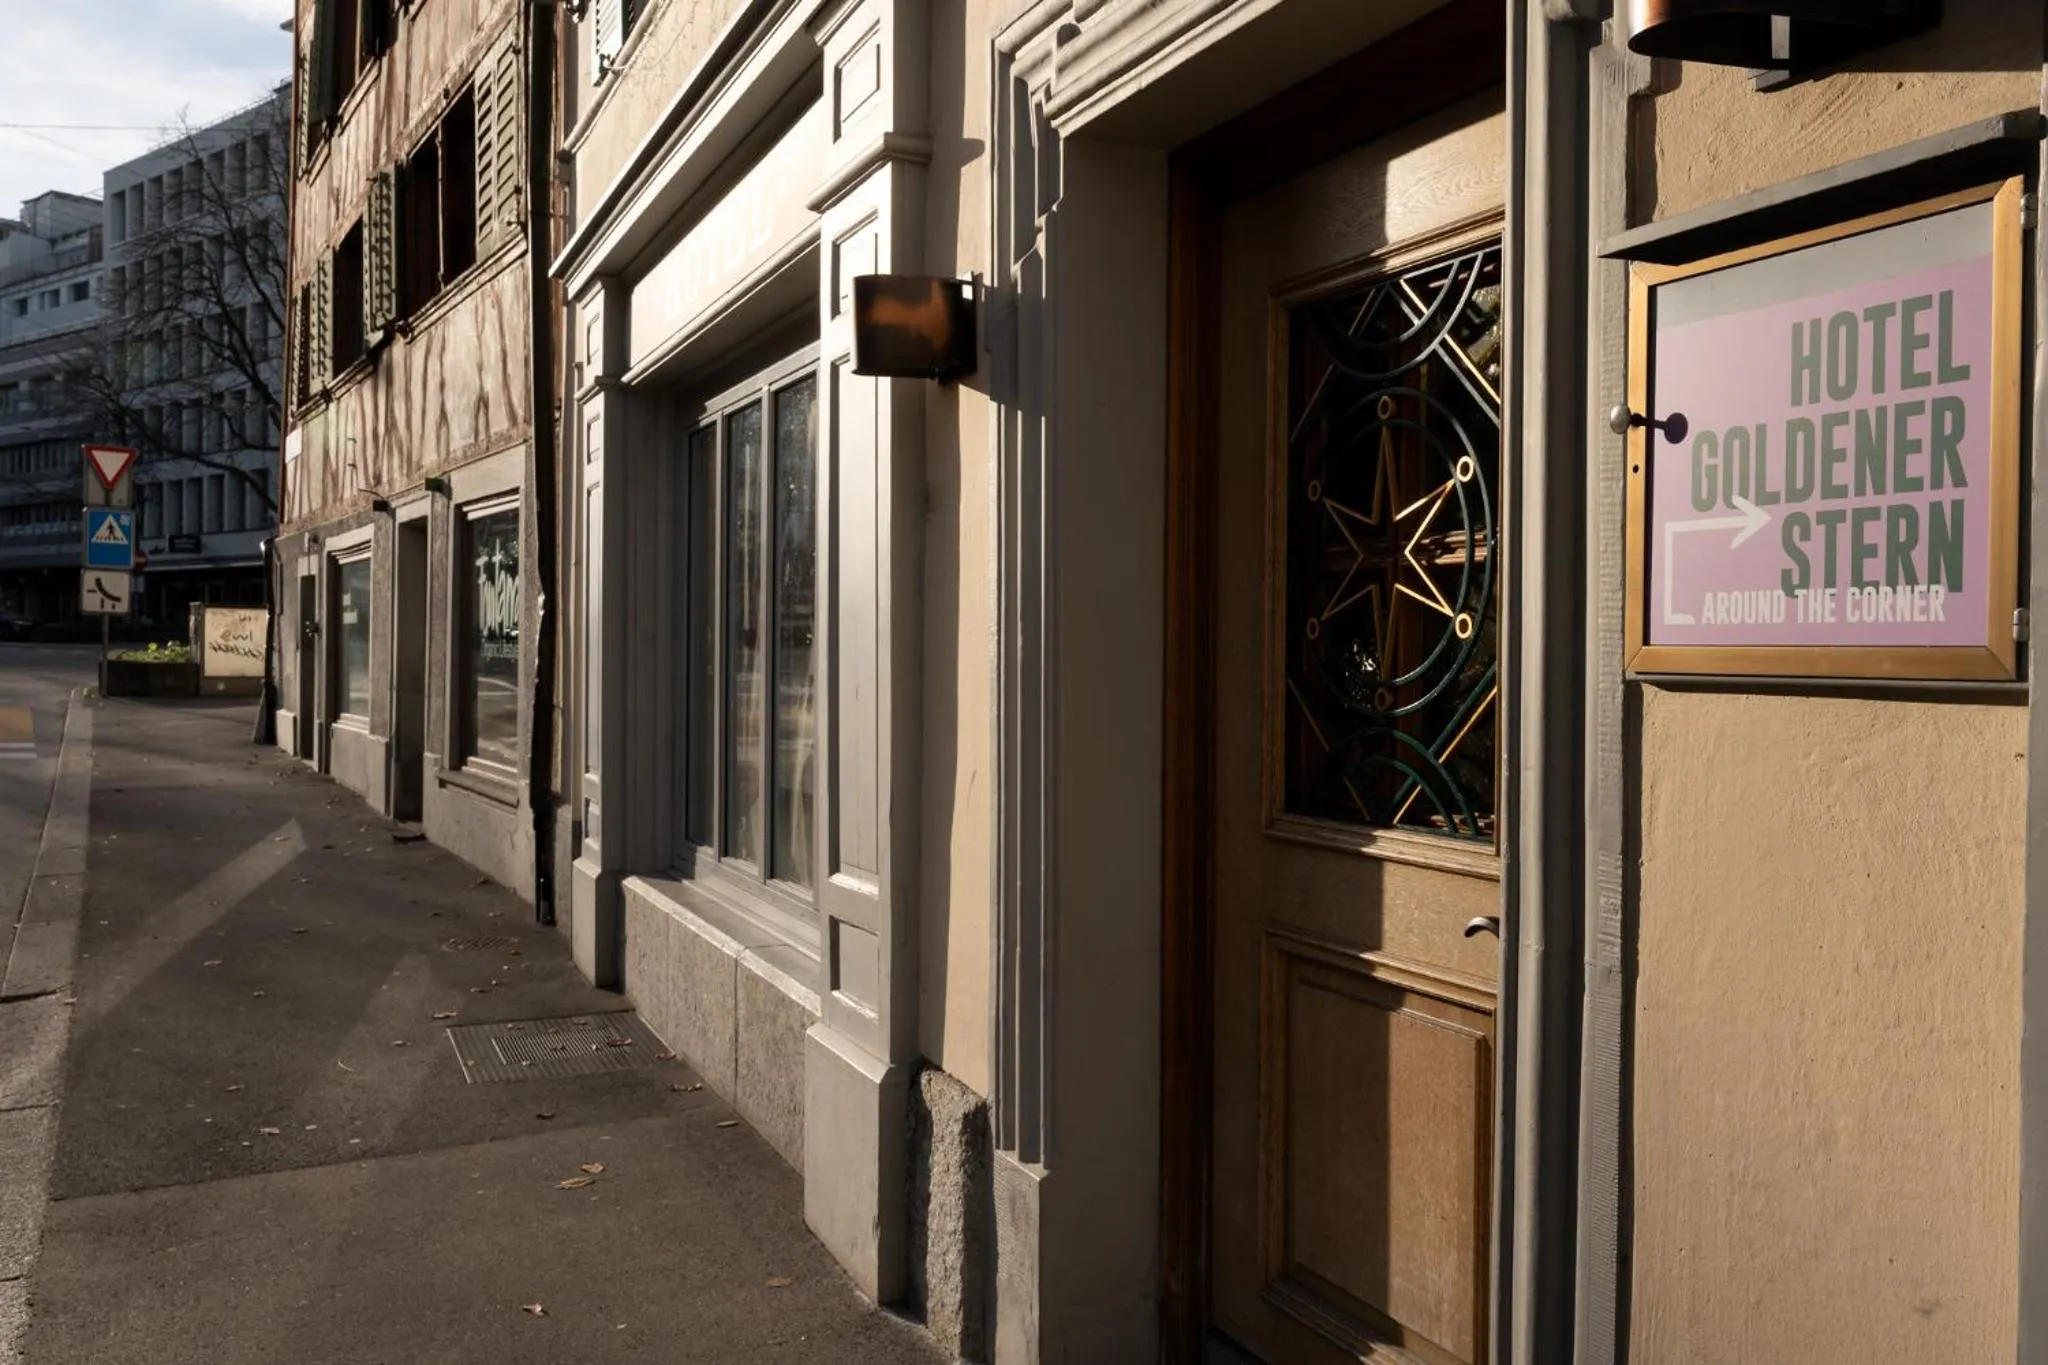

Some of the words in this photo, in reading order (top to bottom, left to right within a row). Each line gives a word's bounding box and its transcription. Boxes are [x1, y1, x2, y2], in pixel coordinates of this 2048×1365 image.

[1790, 289, 1971, 408] HOTEL
[1691, 395, 1969, 513] GOLDENER
[1780, 498, 1965, 599] STERN
[1702, 588, 1786, 625] AROUND
[1794, 587, 1838, 624] THE
[1846, 584, 1946, 624] CORNER
